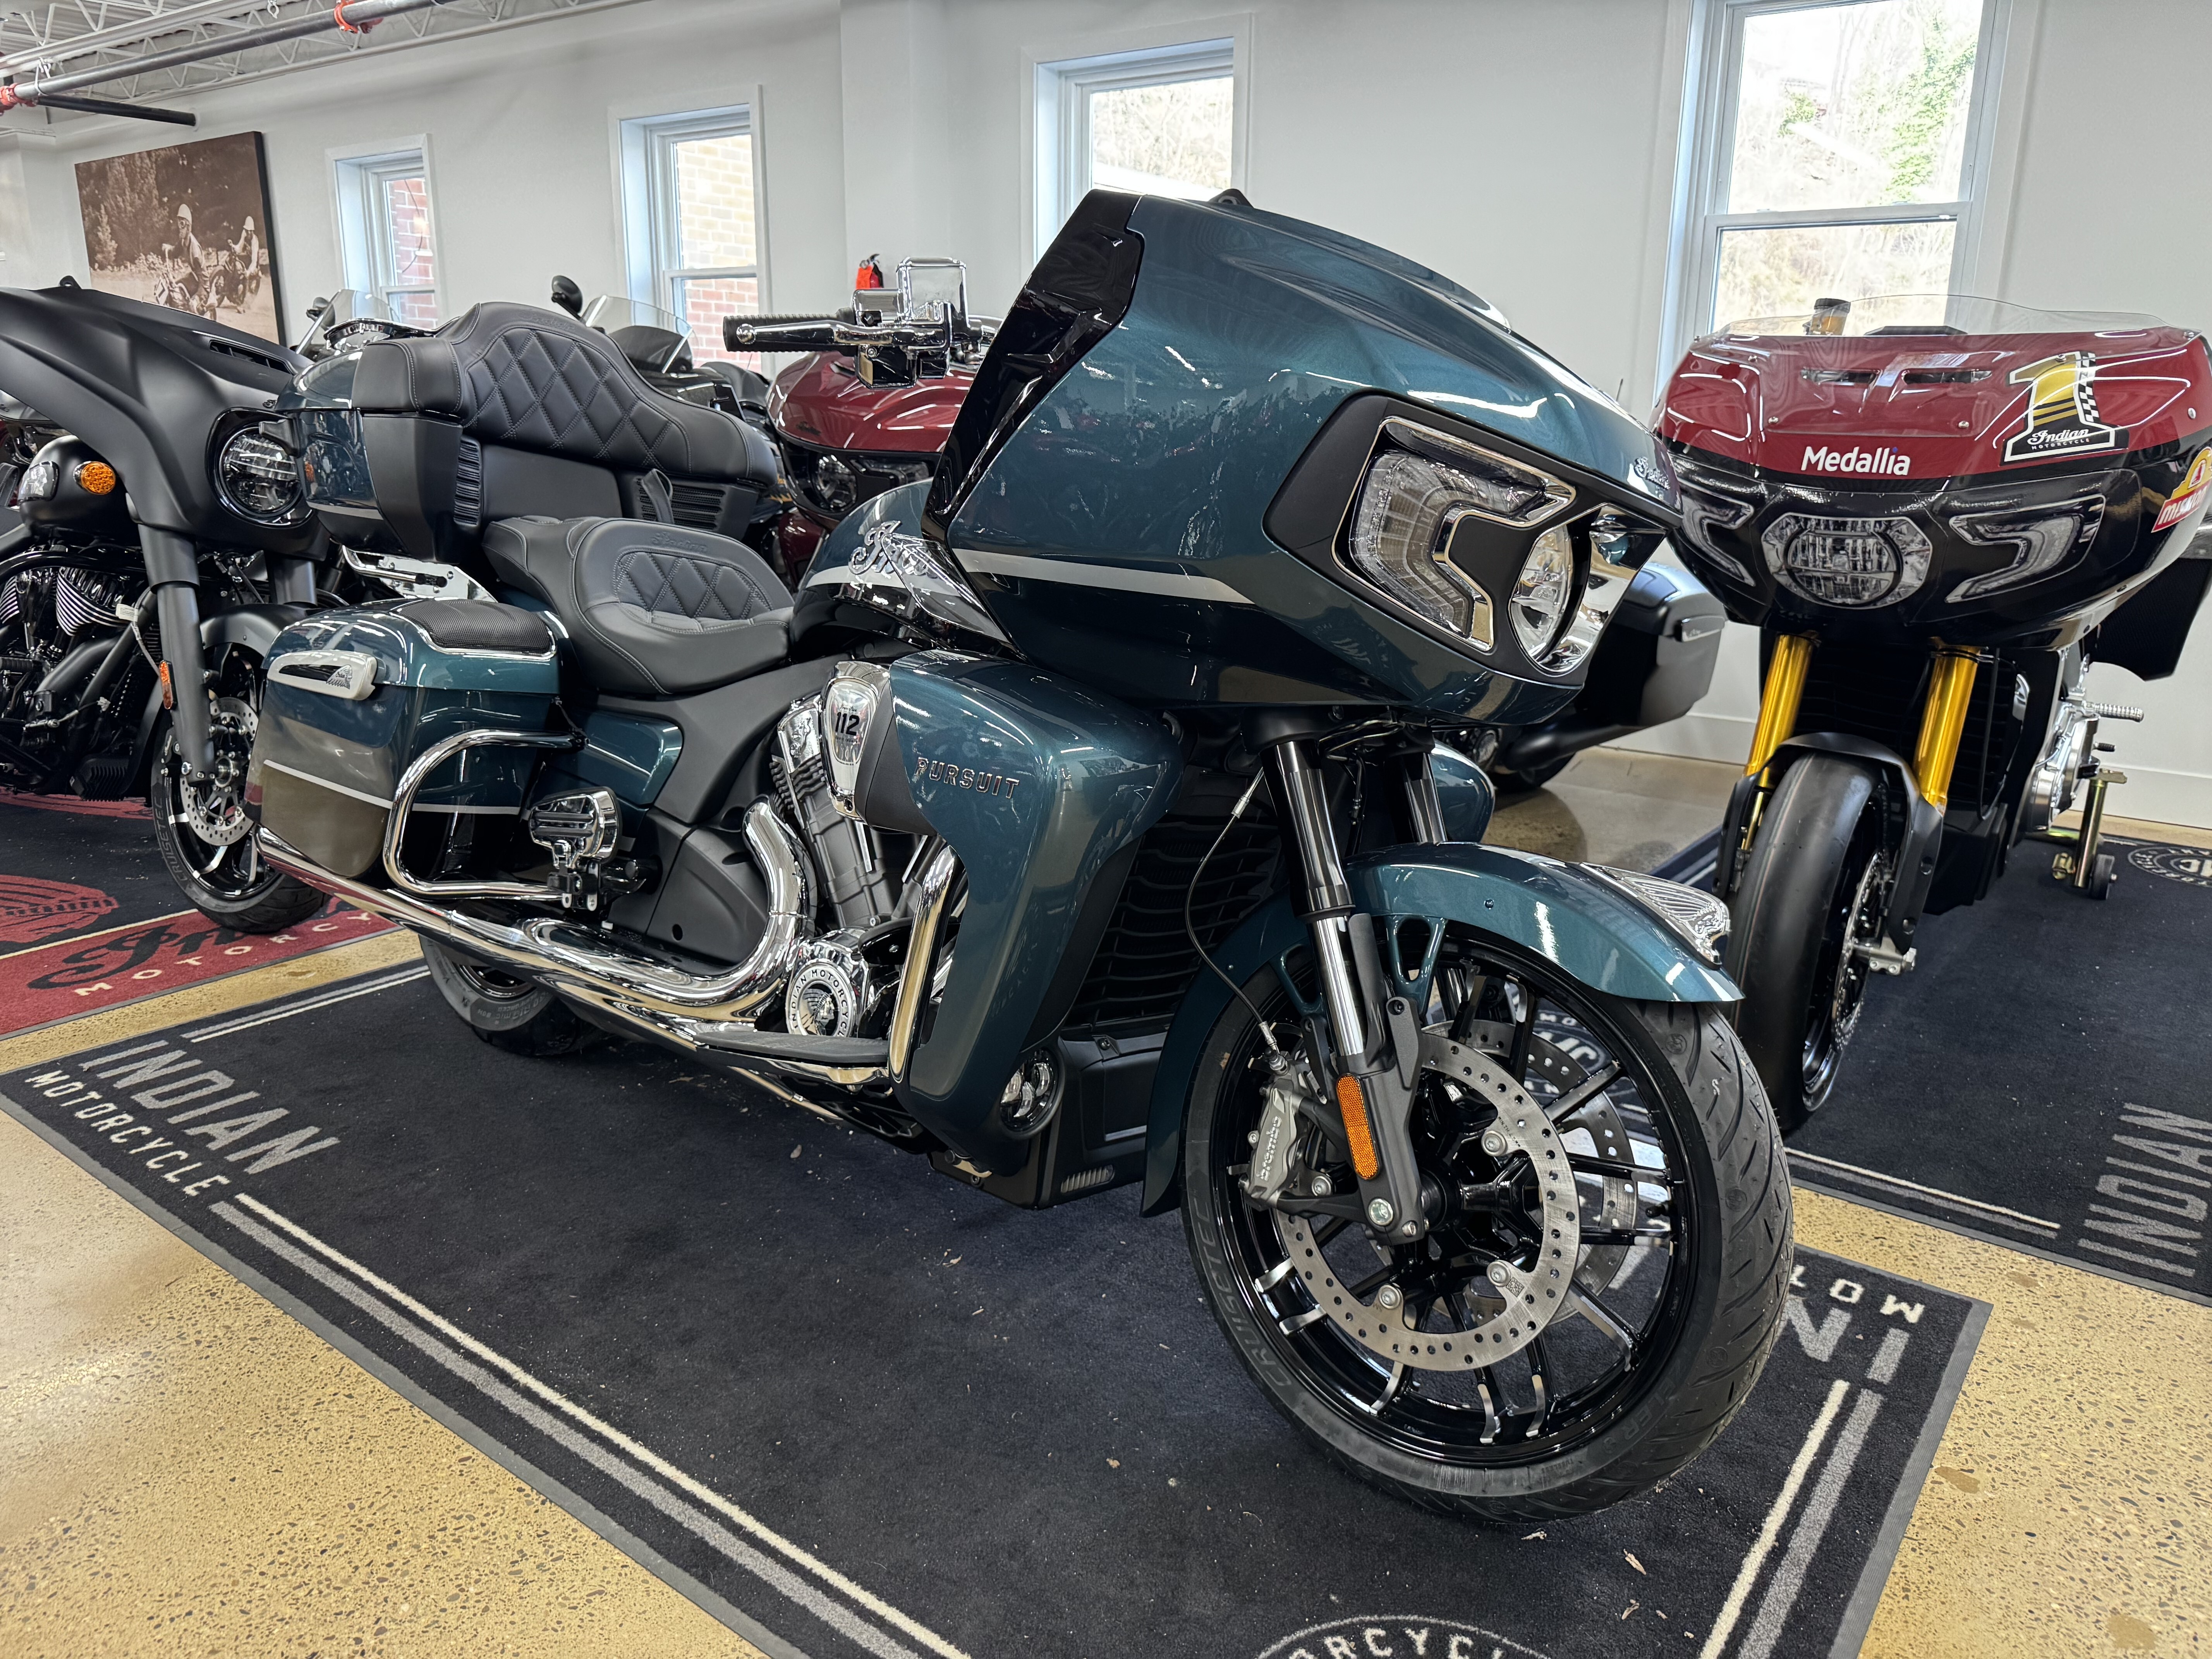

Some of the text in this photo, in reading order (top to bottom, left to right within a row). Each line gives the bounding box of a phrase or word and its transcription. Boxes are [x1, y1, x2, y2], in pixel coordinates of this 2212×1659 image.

[1801, 446, 1910, 476] Medallia
[2027, 429, 2089, 445] Indian
[2032, 438, 2090, 450] MOTORCYCLE
[835, 712, 860, 736] 112
[914, 757, 1020, 799] PURSUIT
[154, 796, 188, 882] CRUISETEC
[791, 975, 807, 1029] INDIAN
[25, 1069, 231, 1197] MOTORCYCLE
[79, 1039, 342, 1175] INDIAN
[1256, 1115, 1282, 1182] brembo
[2077, 1102, 2212, 1278] INDIAN
[1194, 1197, 1292, 1386] CRUISETEC
